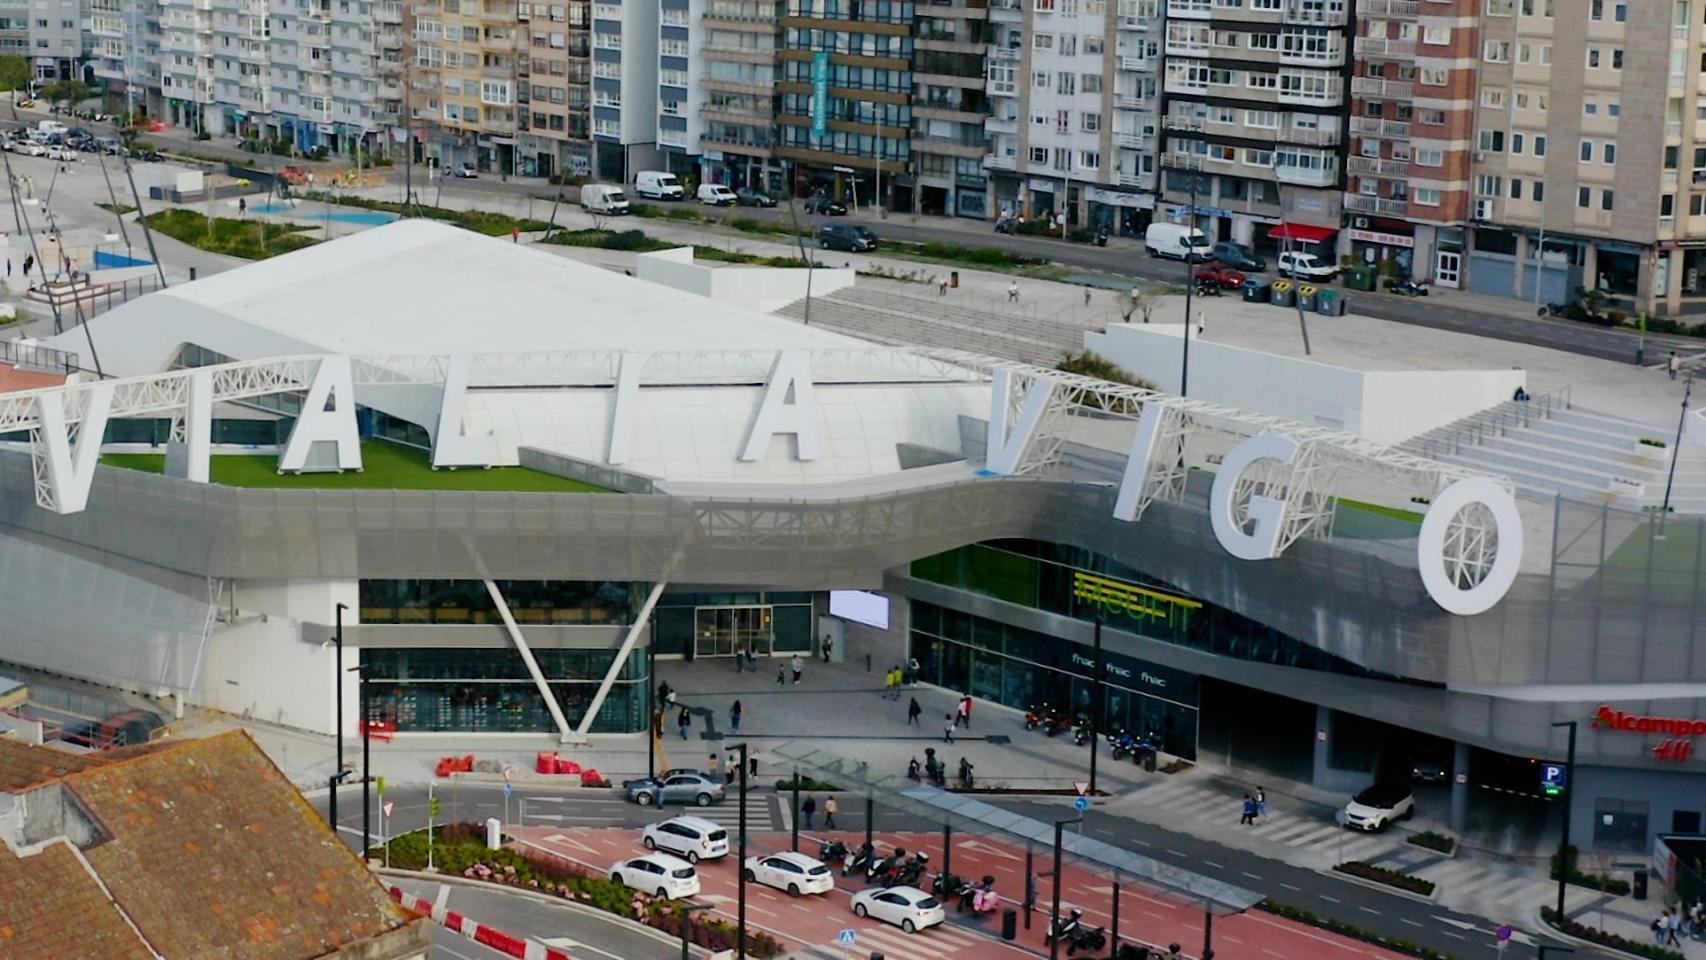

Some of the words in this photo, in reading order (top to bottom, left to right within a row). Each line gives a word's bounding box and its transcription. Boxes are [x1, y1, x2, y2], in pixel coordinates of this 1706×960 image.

[33, 349, 819, 515] VIALIA
[985, 367, 1523, 616] VIGO
[1072, 652, 1096, 669] fnac
[1106, 662, 1131, 678] fnac
[1141, 671, 1167, 687] fnac
[1590, 704, 1706, 737] Alcampo
[1547, 766, 1559, 780] P
